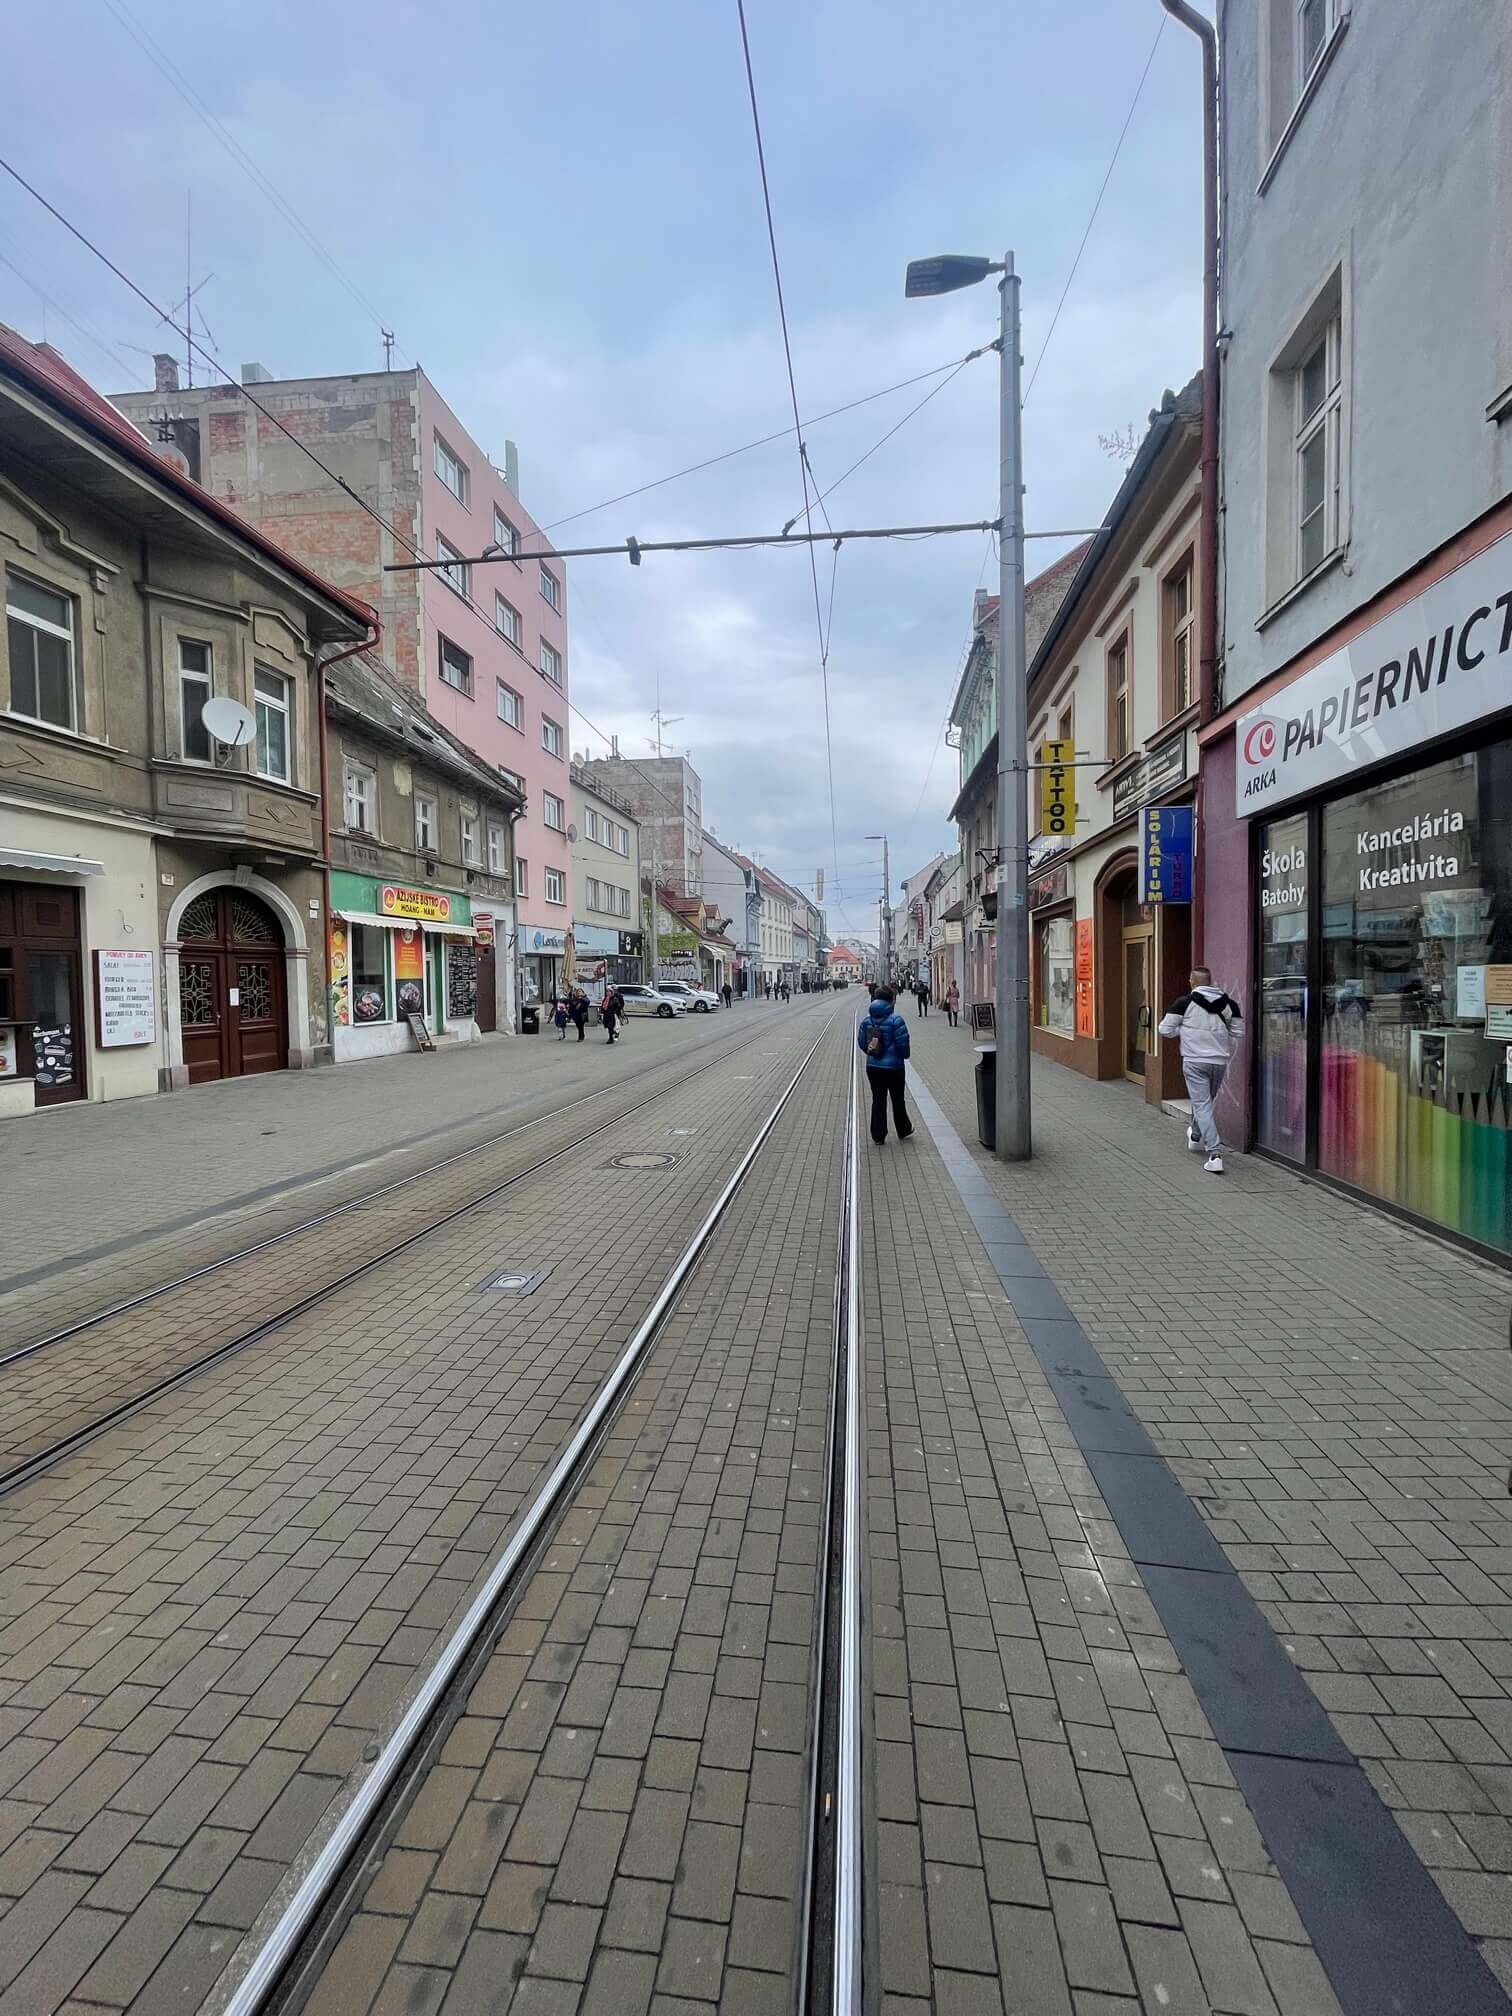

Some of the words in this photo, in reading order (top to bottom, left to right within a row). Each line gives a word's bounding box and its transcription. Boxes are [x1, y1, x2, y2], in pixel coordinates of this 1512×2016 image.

[1049, 743, 1065, 832] TATTOO
[1244, 767, 1277, 798] ARKA
[1357, 808, 1464, 854] Kancelária
[1148, 810, 1163, 902] SOLARIUM
[1262, 845, 1305, 879] Škola
[1359, 854, 1459, 891] Kreativita
[420, 893, 439, 907] BISTRO
[1262, 883, 1305, 907] Batohy
